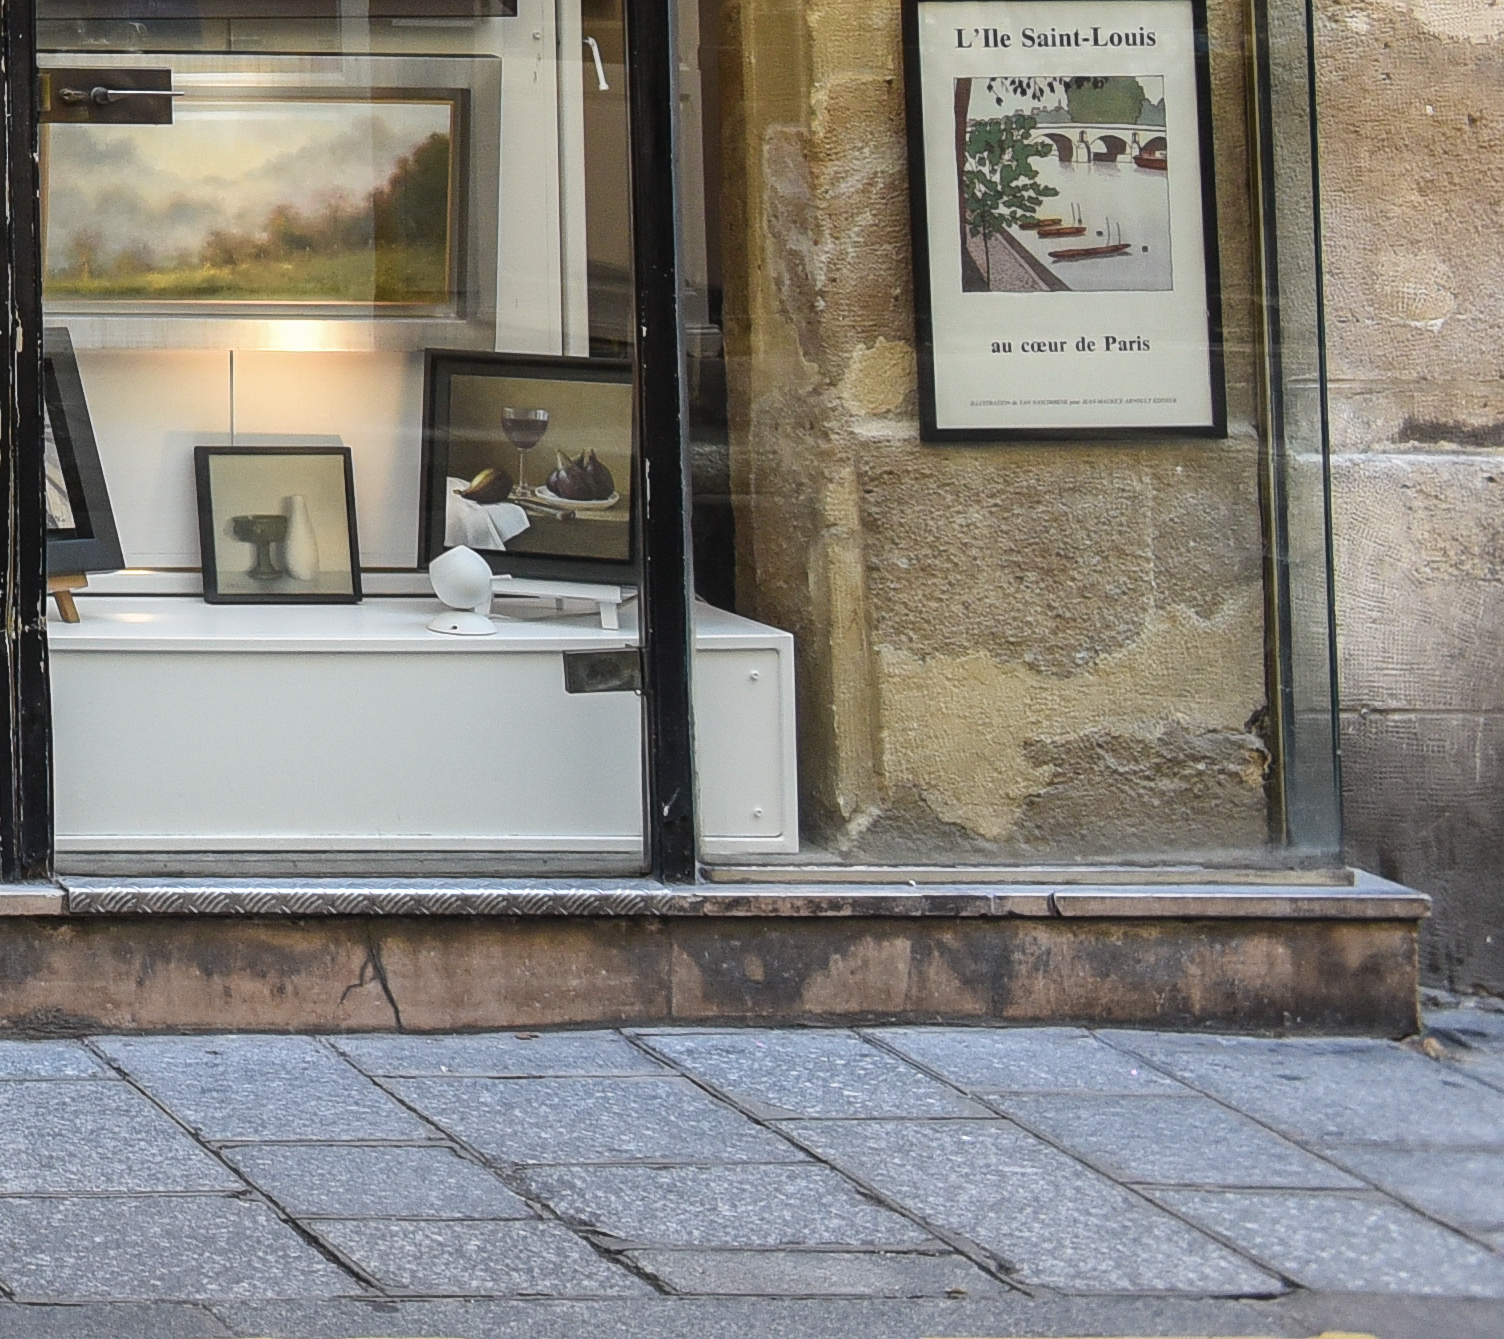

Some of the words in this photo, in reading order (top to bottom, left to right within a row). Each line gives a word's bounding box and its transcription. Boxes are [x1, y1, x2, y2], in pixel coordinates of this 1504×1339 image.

[954, 27, 1012, 51] L'Ile
[1021, 24, 1158, 50] Saint-Louis
[990, 340, 1014, 355] au
[1020, 339, 1068, 354] cœur
[1075, 335, 1097, 354] de
[1104, 334, 1152, 354] Paris
